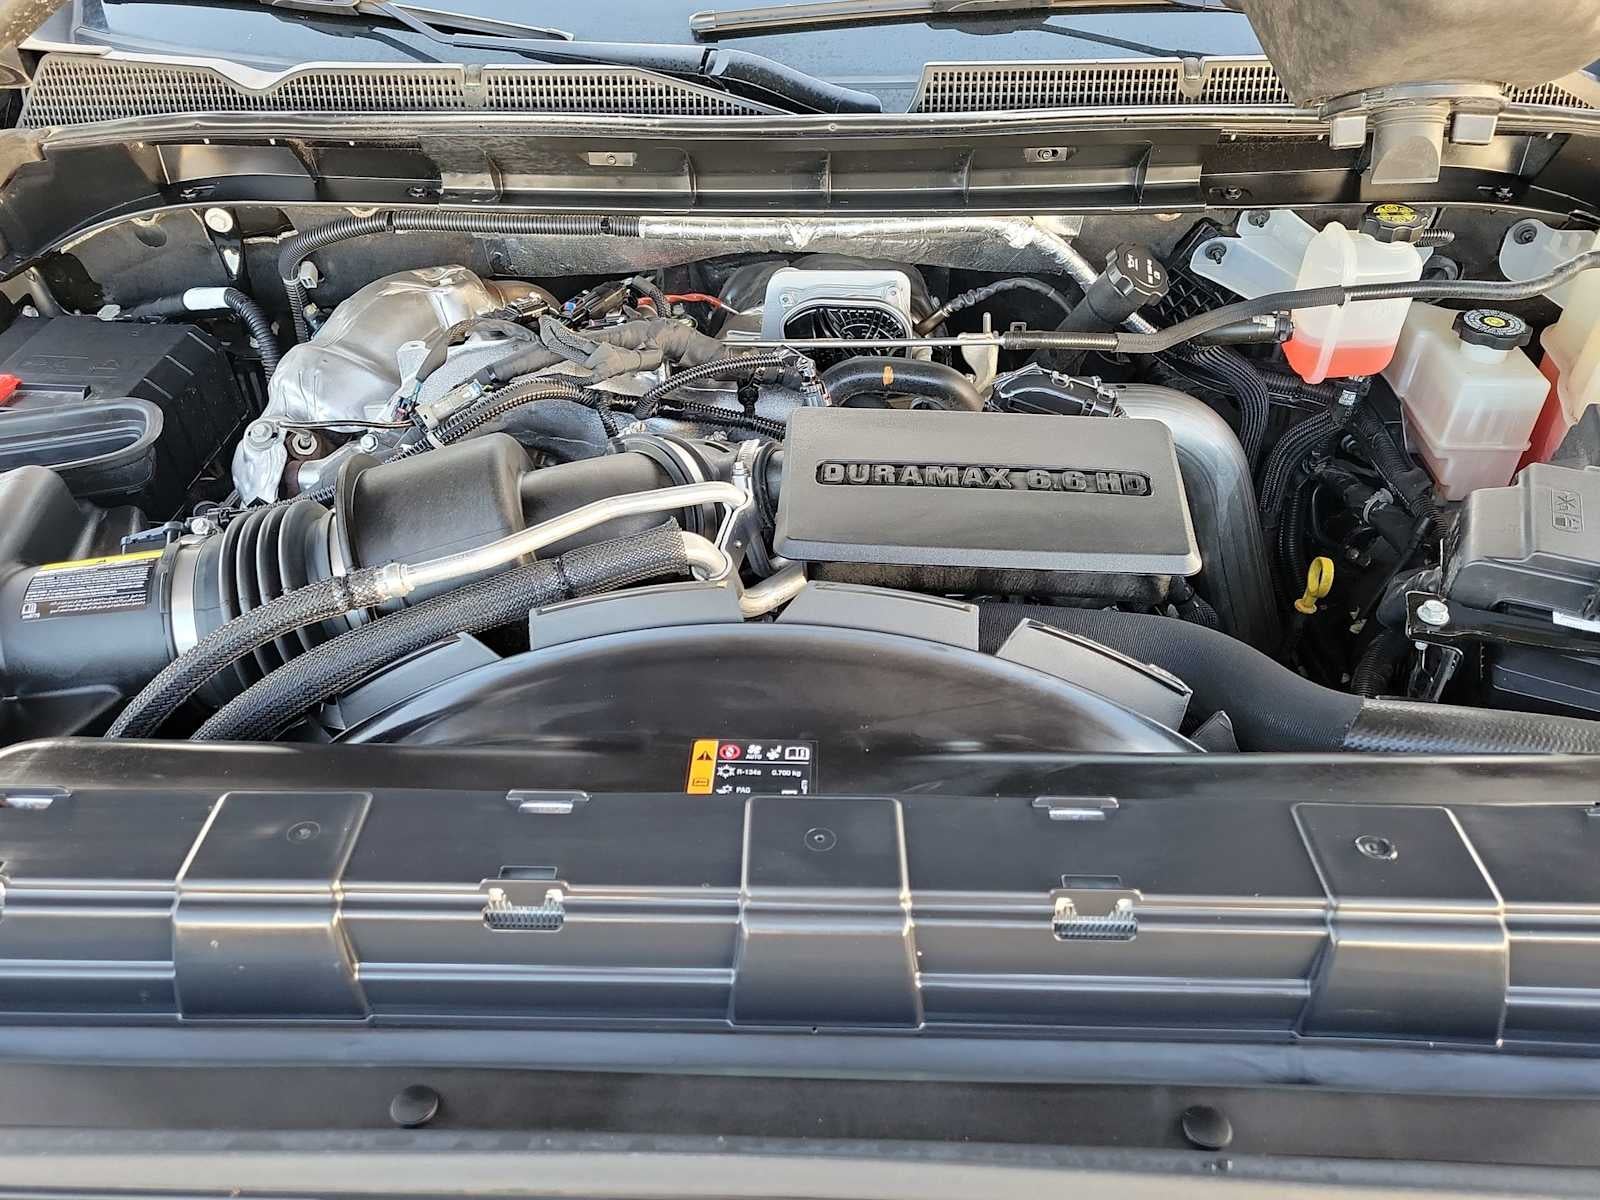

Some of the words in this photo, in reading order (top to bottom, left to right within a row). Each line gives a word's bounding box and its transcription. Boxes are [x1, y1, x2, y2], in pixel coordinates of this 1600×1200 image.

[822, 463, 1014, 489] DURAMAX
[1026, 469, 1088, 492] 6.6
[1095, 472, 1149, 496] HD
